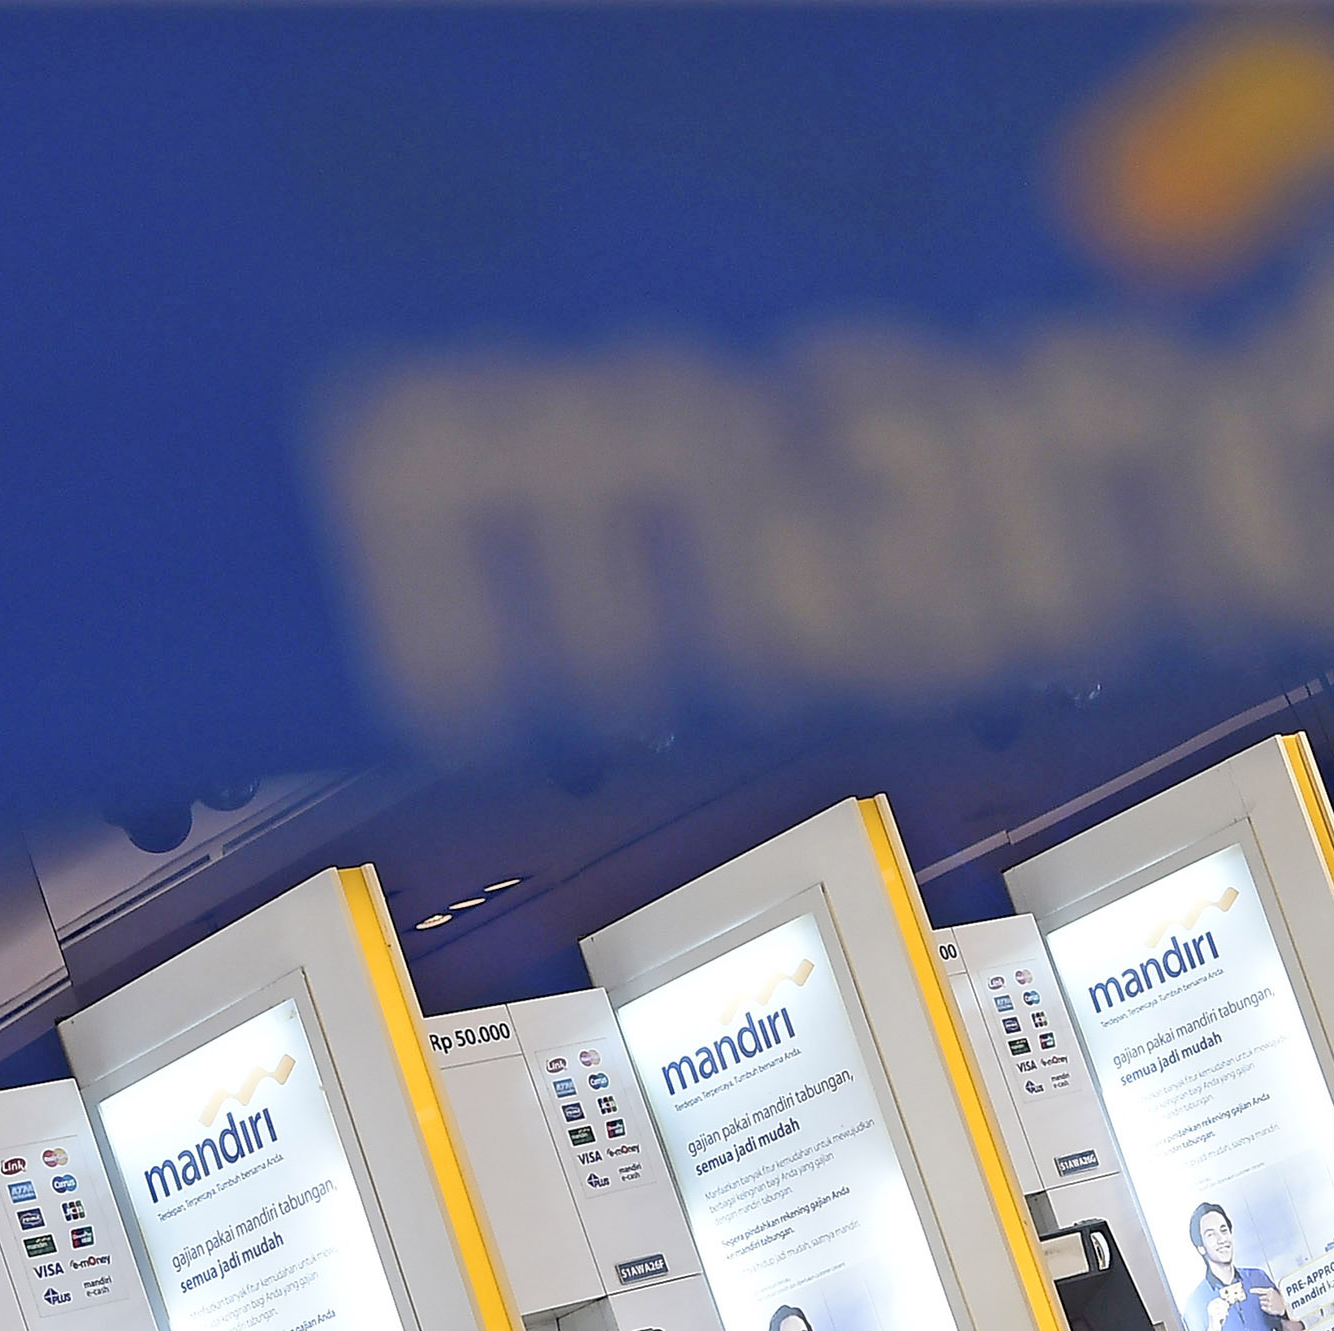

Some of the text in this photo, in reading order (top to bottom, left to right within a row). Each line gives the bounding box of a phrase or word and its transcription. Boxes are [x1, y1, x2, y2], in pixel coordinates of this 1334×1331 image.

[1088, 930, 1220, 1013] mandiri
[429, 1022, 511, 1055] Rp 50.000
[662, 1006, 796, 1096] mandiri
[1113, 1043, 1146, 1070] gajian
[1146, 1028, 1175, 1056] pakai
[1175, 1007, 1218, 1038] mandiri
[1120, 1031, 1223, 1087] semua jadi mudah
[687, 1067, 855, 1158] gajian pakai mandiri tabungan,
[2, 1159, 26, 1175] Link
[144, 1107, 278, 1204] mandiri
[577, 1149, 603, 1166] VISA
[696, 1116, 801, 1177] semua jadi mudah
[171, 1239, 206, 1273] gajian
[205, 1224, 235, 1256] pakai
[235, 1202, 279, 1239] mandiri
[180, 1231, 285, 1295] semua jadi mudah
[34, 1262, 64, 1279] VISA
[1291, 1283, 1327, 1310] mandiri
